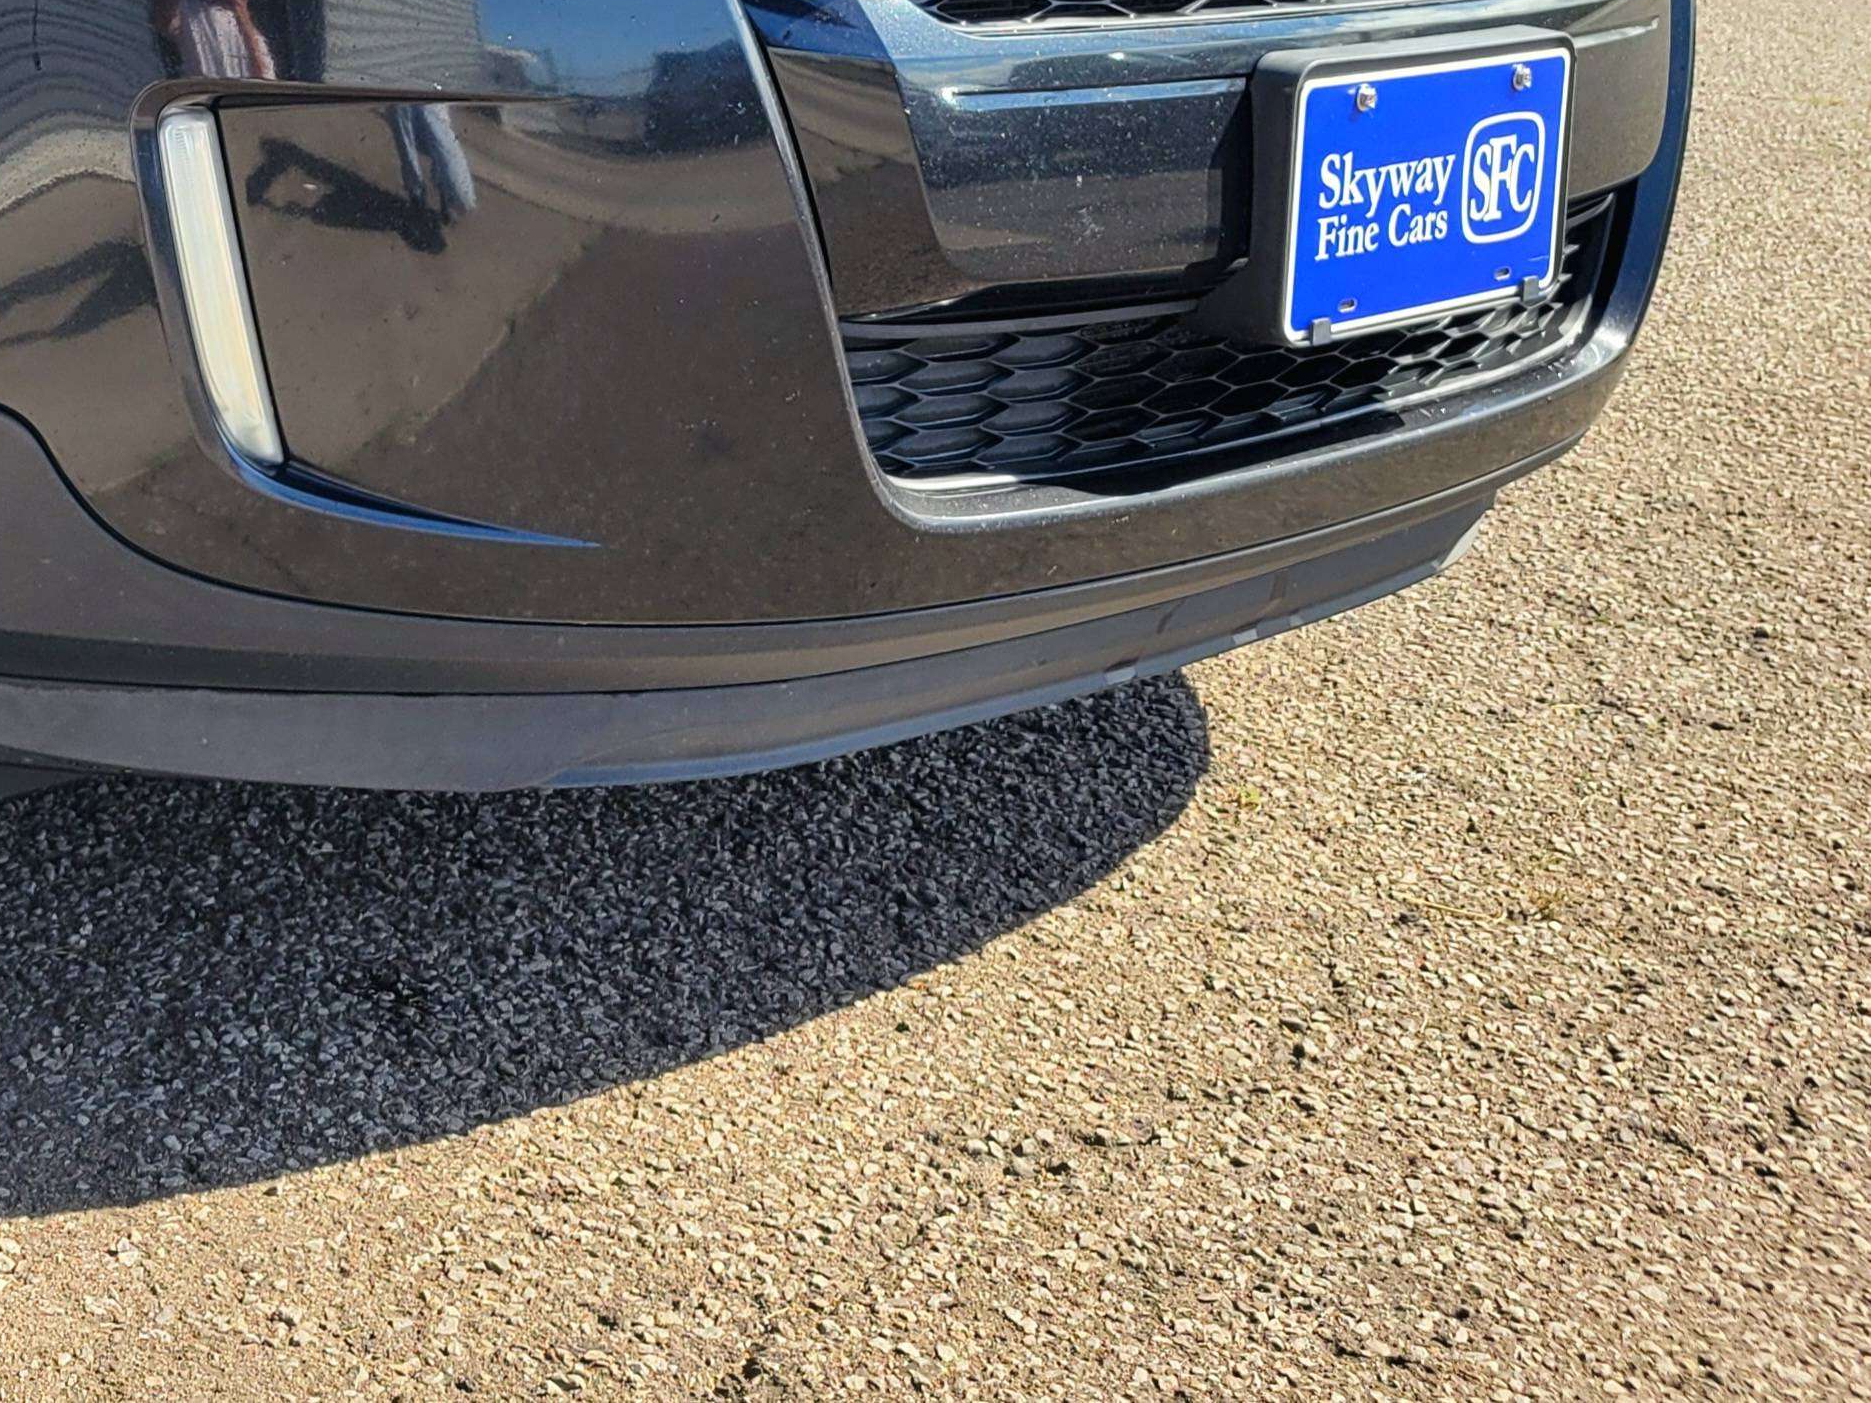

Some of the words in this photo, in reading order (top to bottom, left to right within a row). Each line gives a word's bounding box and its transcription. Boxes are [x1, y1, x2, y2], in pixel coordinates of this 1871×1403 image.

[1318, 150, 1456, 218] Skyway
[1470, 134, 1536, 223] SFC
[1314, 214, 1380, 261] Fine
[1387, 203, 1449, 247] Cars
